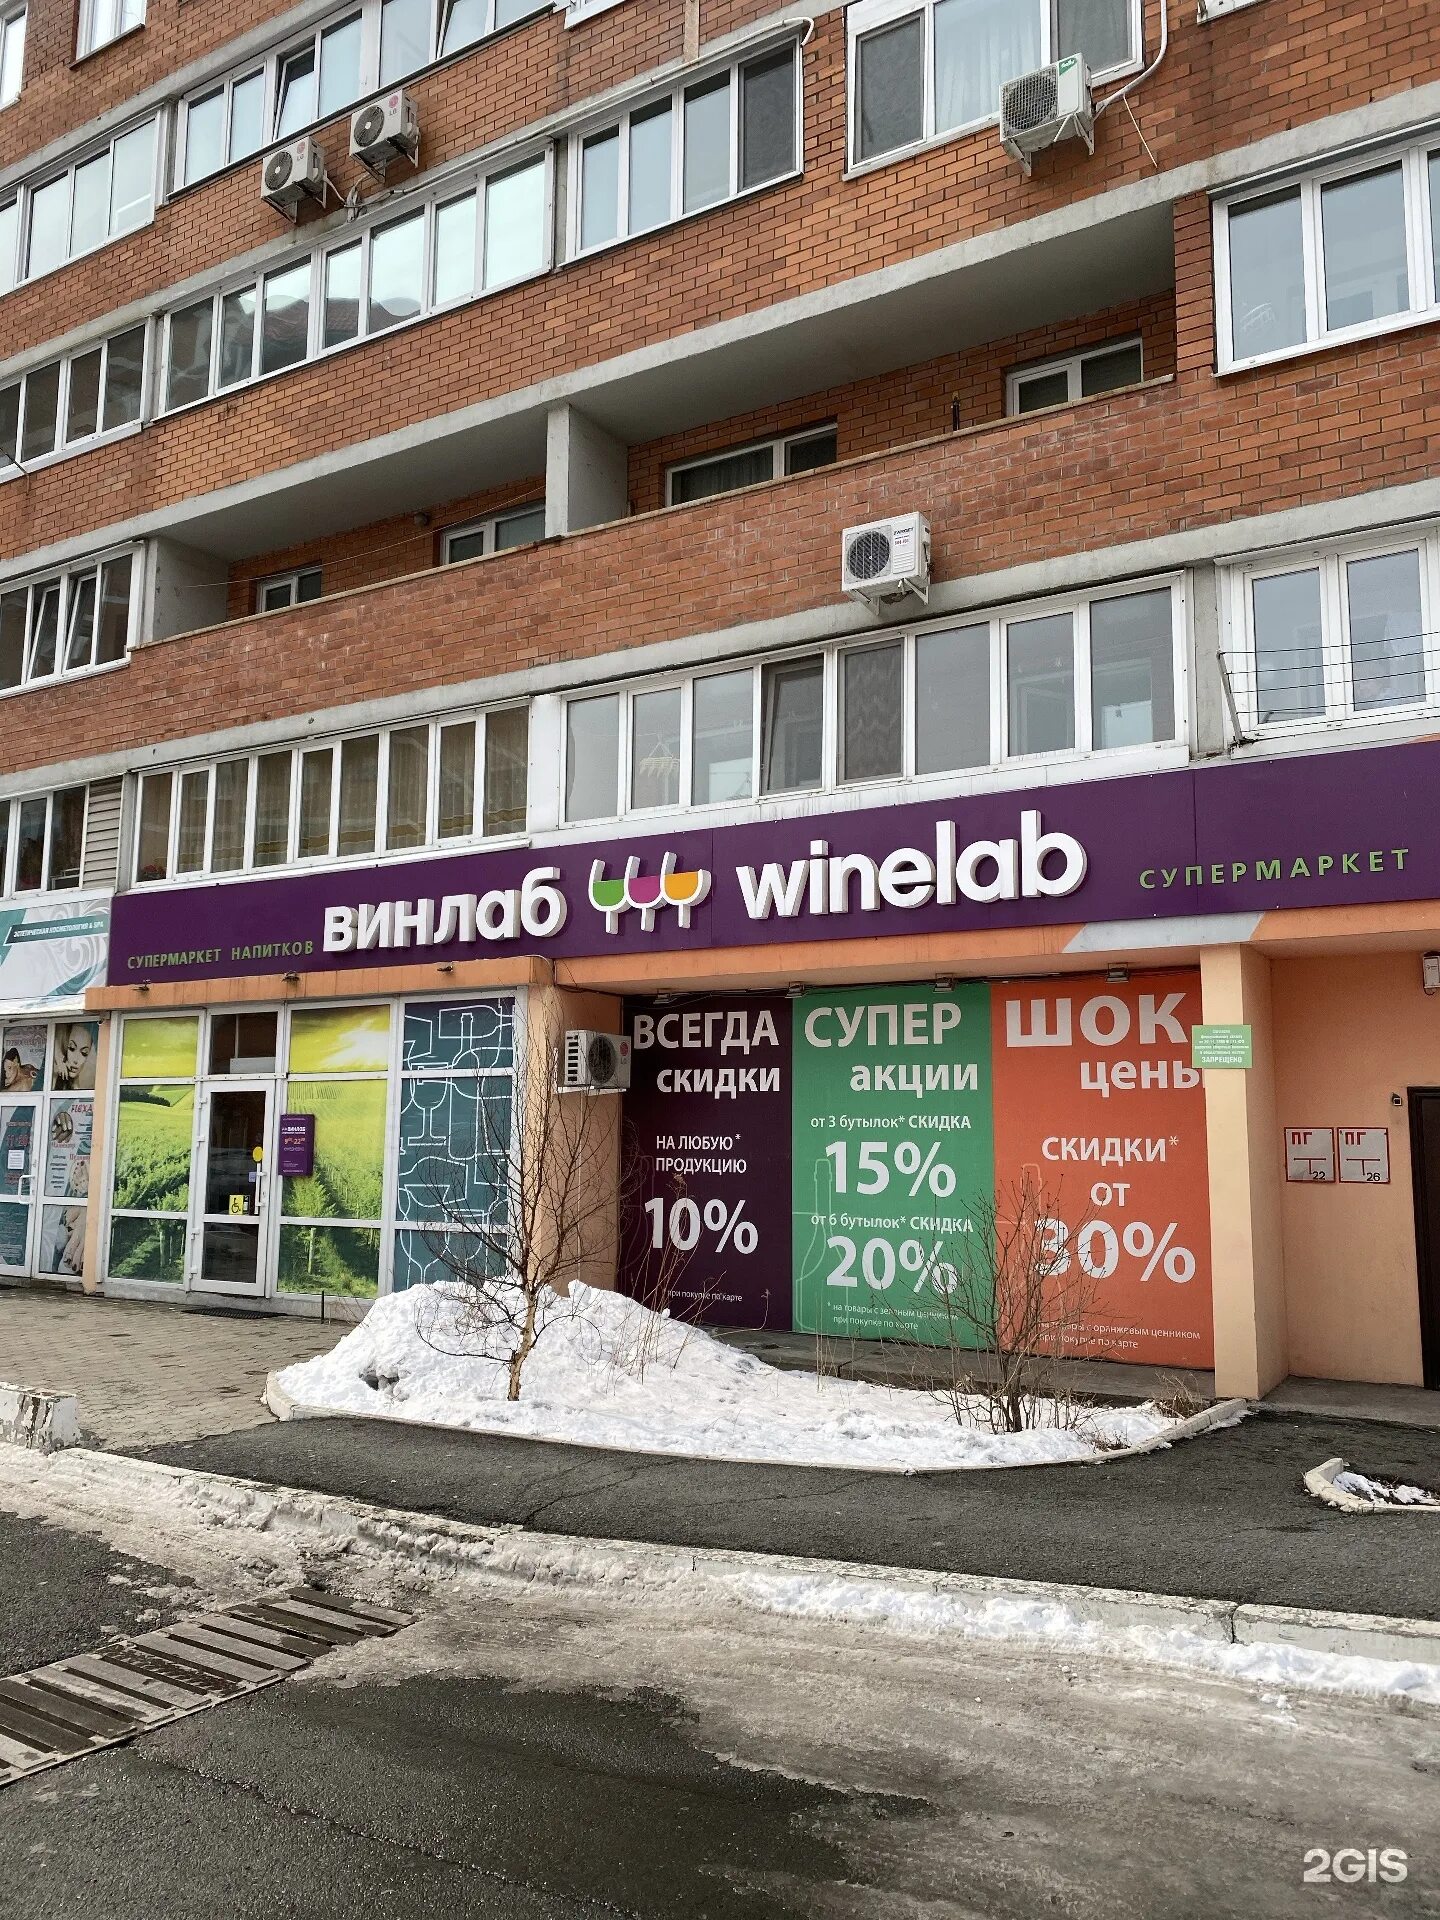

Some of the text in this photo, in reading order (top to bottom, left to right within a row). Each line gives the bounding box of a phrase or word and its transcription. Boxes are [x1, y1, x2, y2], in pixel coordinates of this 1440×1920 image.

[735, 809, 1088, 920] winelab
[1139, 848, 1409, 889] СУПЕРМАРКЕТ
[127, 940, 314, 970] СУПЕРМАРКЕТ НАПИТКОВ
[804, 1003, 962, 1048] СУПЕР
[1005, 992, 1189, 1048] ШОК
[633, 1010, 780, 1056] ВСЕГДА
[656, 1067, 780, 1100] скидки
[849, 1063, 978, 1099] акции
[810, 1117, 826, 1128] от
[828, 1116, 836, 1128] 3
[908, 1115, 972, 1132] СКИДКА
[656, 1135, 676, 1150] НА
[1292, 1132, 1313, 1145] ПГ
[1345, 1132, 1367, 1145] ПГ
[655, 1157, 747, 1175] ПРОДУКЦИЮ
[825, 1141, 957, 1198] 15%
[1312, 1171, 1326, 1180] 22
[1366, 1172, 1381, 1181] 26
[644, 1197, 759, 1255] 10%
[811, 1214, 826, 1225] от
[828, 1213, 837, 1226] 6
[910, 1216, 974, 1234] СКИДКА
[1033, 1218, 1196, 1284] 30%
[826, 1235, 958, 1295] 20%
[722, 1293, 743, 1303] карте
[833, 1316, 848, 1325] при
[849, 1317, 882, 1328] покупке
[883, 1320, 894, 1328] по
[844, 1304, 873, 1315] товары
[916, 1311, 959, 1321] ценникм
[1093, 1325, 1149, 1336] оранжевым
[1151, 1329, 1201, 1339] ценником
